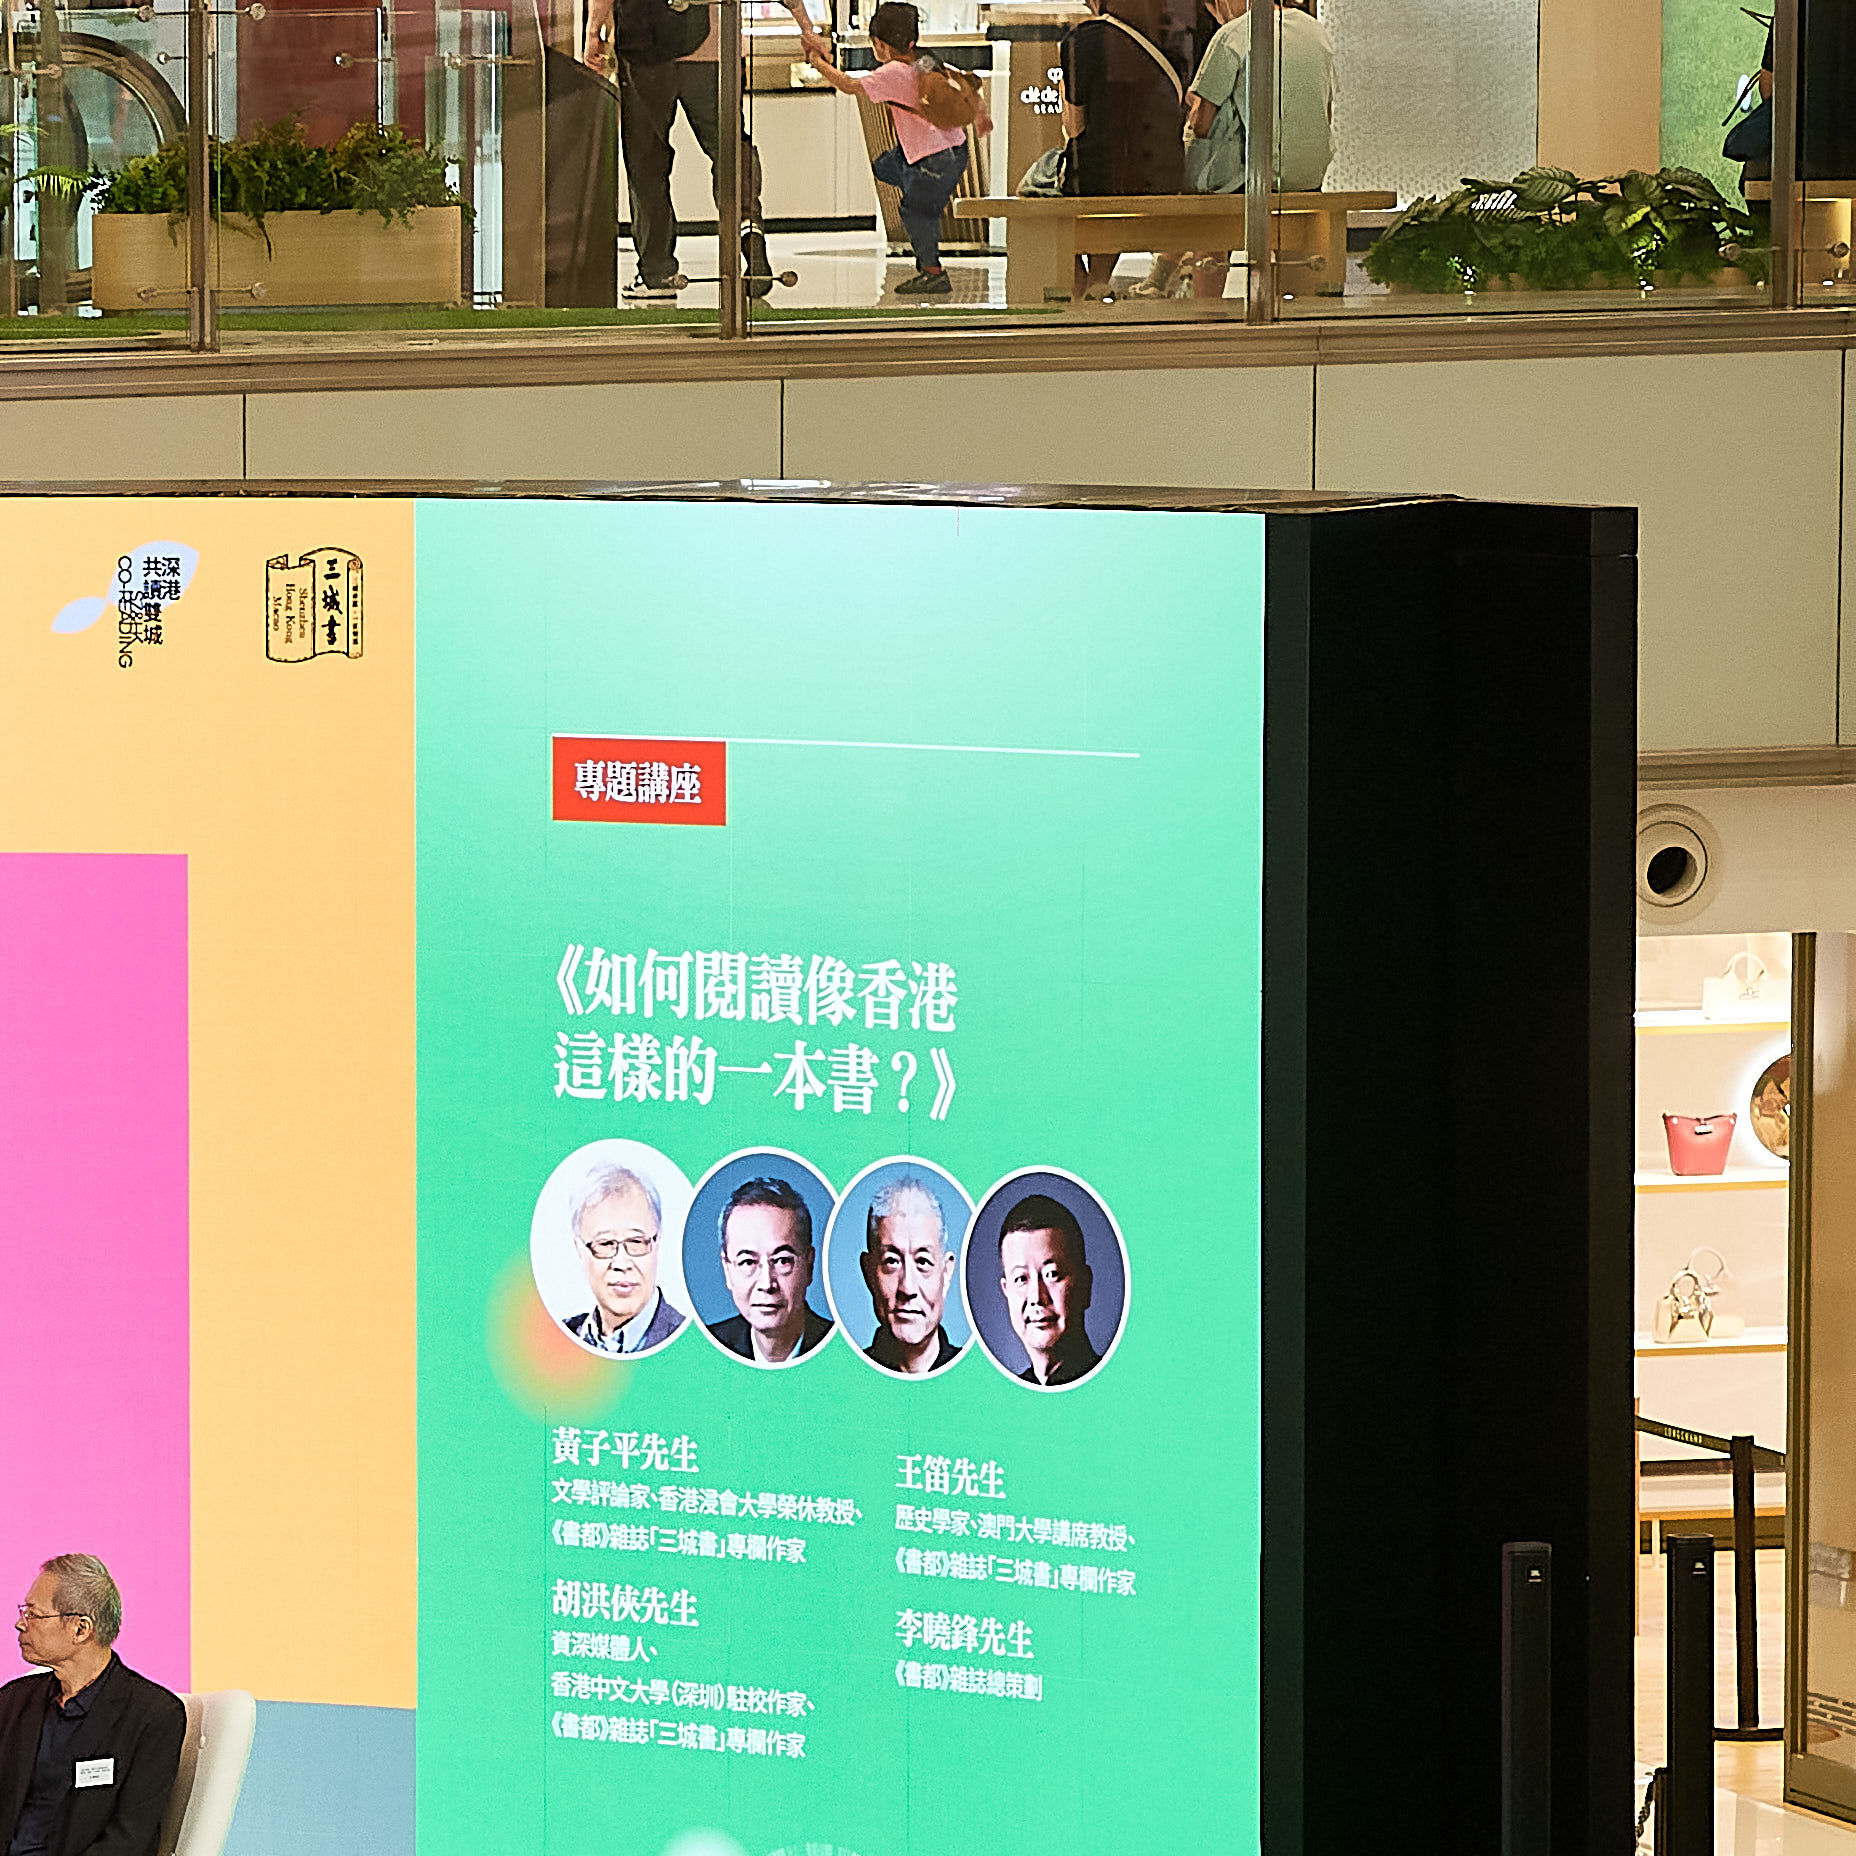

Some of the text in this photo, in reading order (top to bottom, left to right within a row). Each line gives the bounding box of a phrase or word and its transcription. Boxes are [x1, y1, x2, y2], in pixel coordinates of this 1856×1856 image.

[161, 556, 181, 601] 深港
[573, 760, 703, 805] 專題講座
[554, 942, 960, 1033] 《如何閱讀像香港
[552, 1031, 957, 1121] 這樣的一本書？》
[552, 1426, 700, 1474] 黃子平先生
[895, 1453, 1007, 1499] 王笛先生
[551, 1578, 700, 1628] 胡洪俠先生
